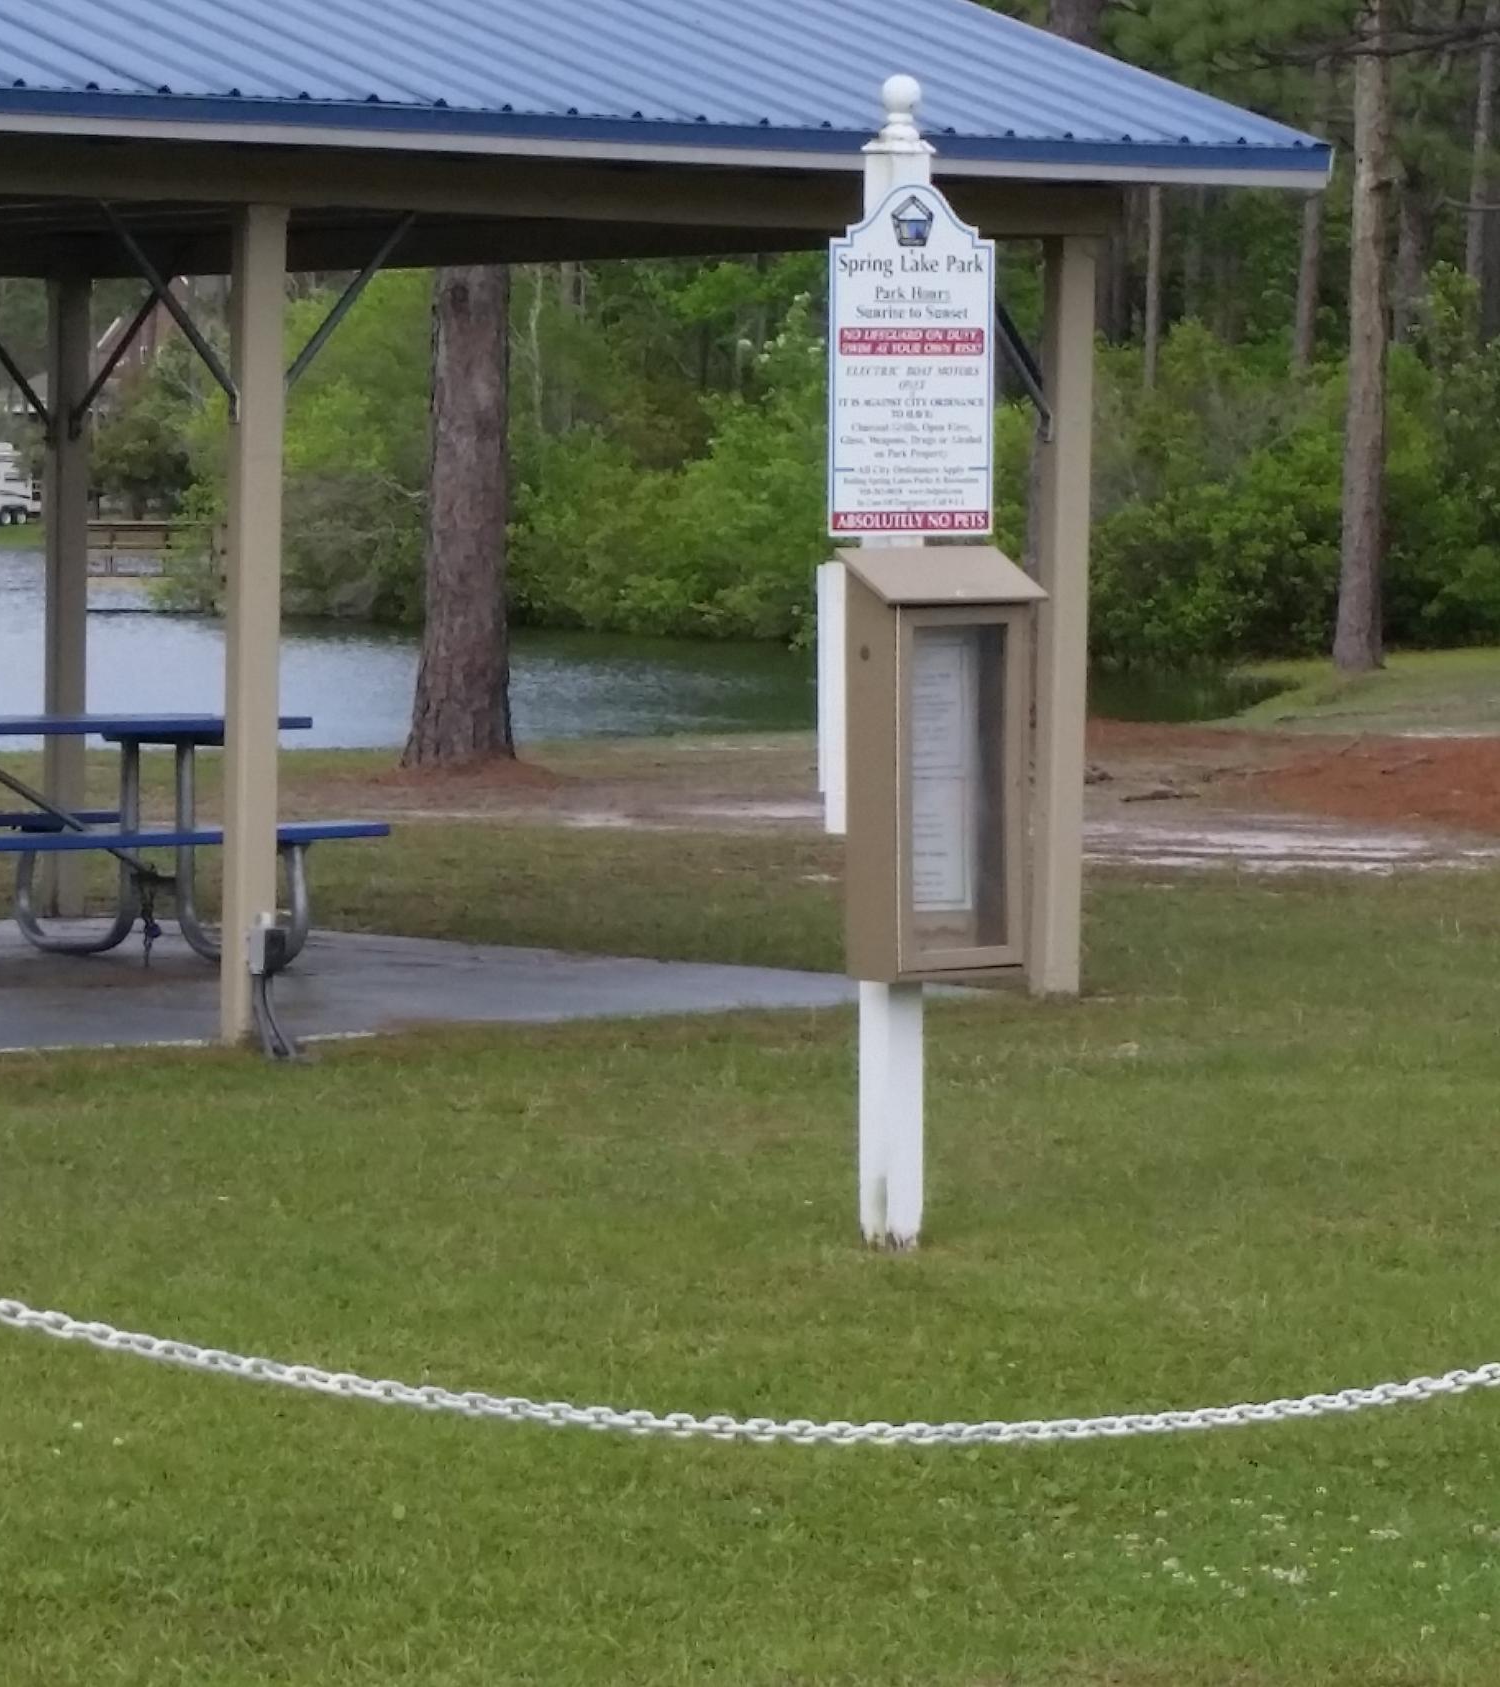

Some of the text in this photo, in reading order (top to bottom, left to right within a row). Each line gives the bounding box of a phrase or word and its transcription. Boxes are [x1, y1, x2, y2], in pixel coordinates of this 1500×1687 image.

[838, 253, 984, 279] Spring Lake Park
[875, 286, 950, 299] Park Hours
[856, 305, 968, 320] Sunrise to Sunset
[843, 329, 861, 340] NO
[864, 329, 923, 340] LIFEGUARD
[926, 329, 943, 340] ON
[892, 343, 920, 354] YOUR
[846, 366, 979, 377] ELECTRIC BOAT MOTORS
[838, 398, 984, 407] IT IS AGAINST CITY ORDINANCE
[837, 513, 985, 528] ABSOLUTELY NO PETS
